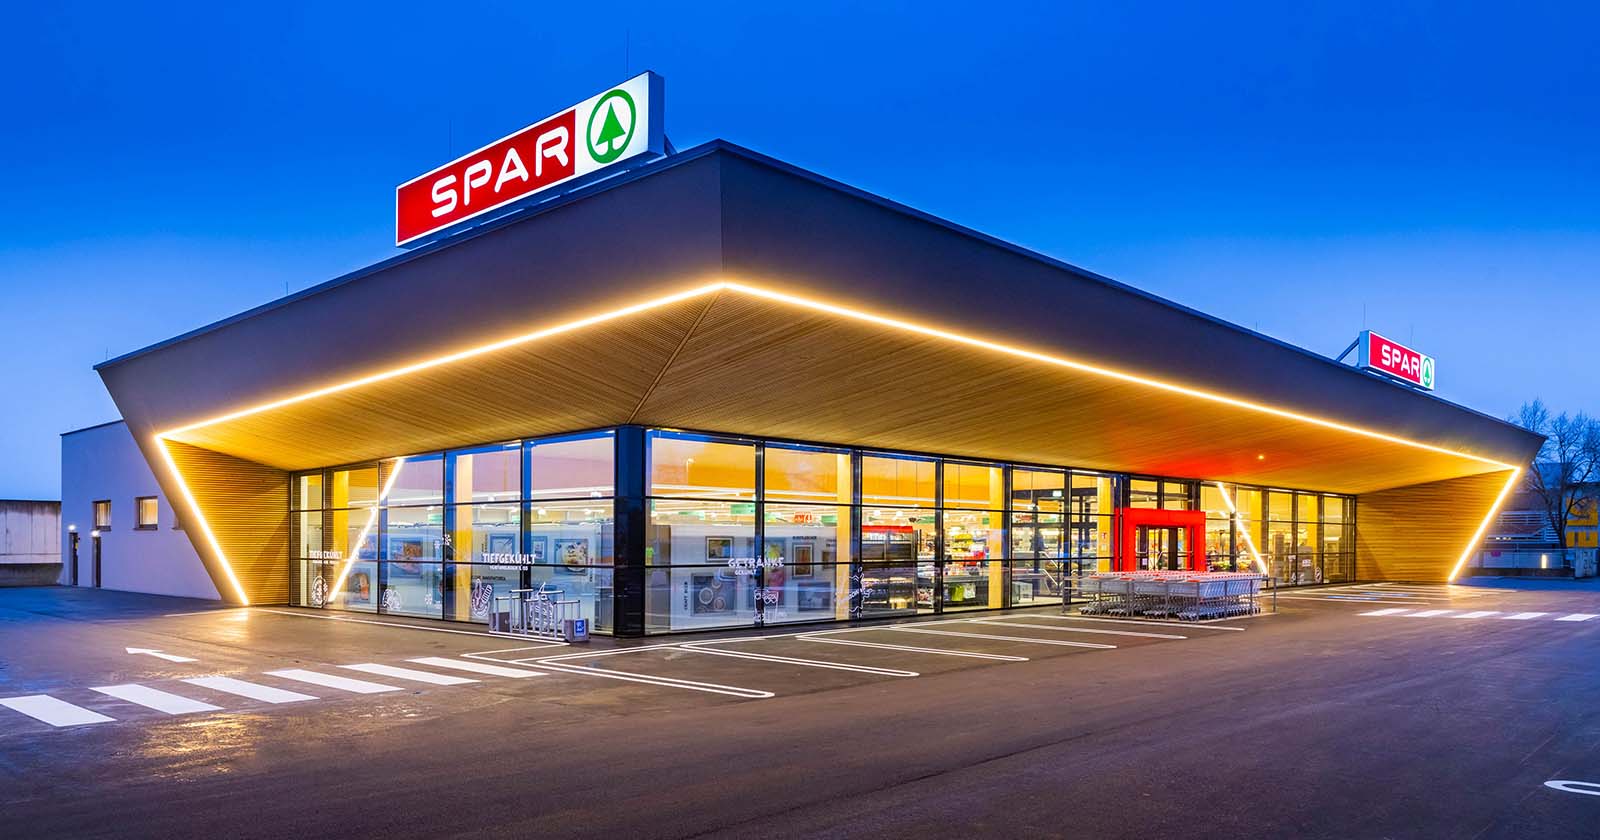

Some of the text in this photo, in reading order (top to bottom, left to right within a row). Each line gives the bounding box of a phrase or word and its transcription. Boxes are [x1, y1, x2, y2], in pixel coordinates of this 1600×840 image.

[431, 126, 569, 218] SPAR
[1381, 344, 1420, 378] SPAR
[482, 551, 536, 564] TIEFGEKÜHLT
[727, 555, 785, 569] GETRÄNKE
